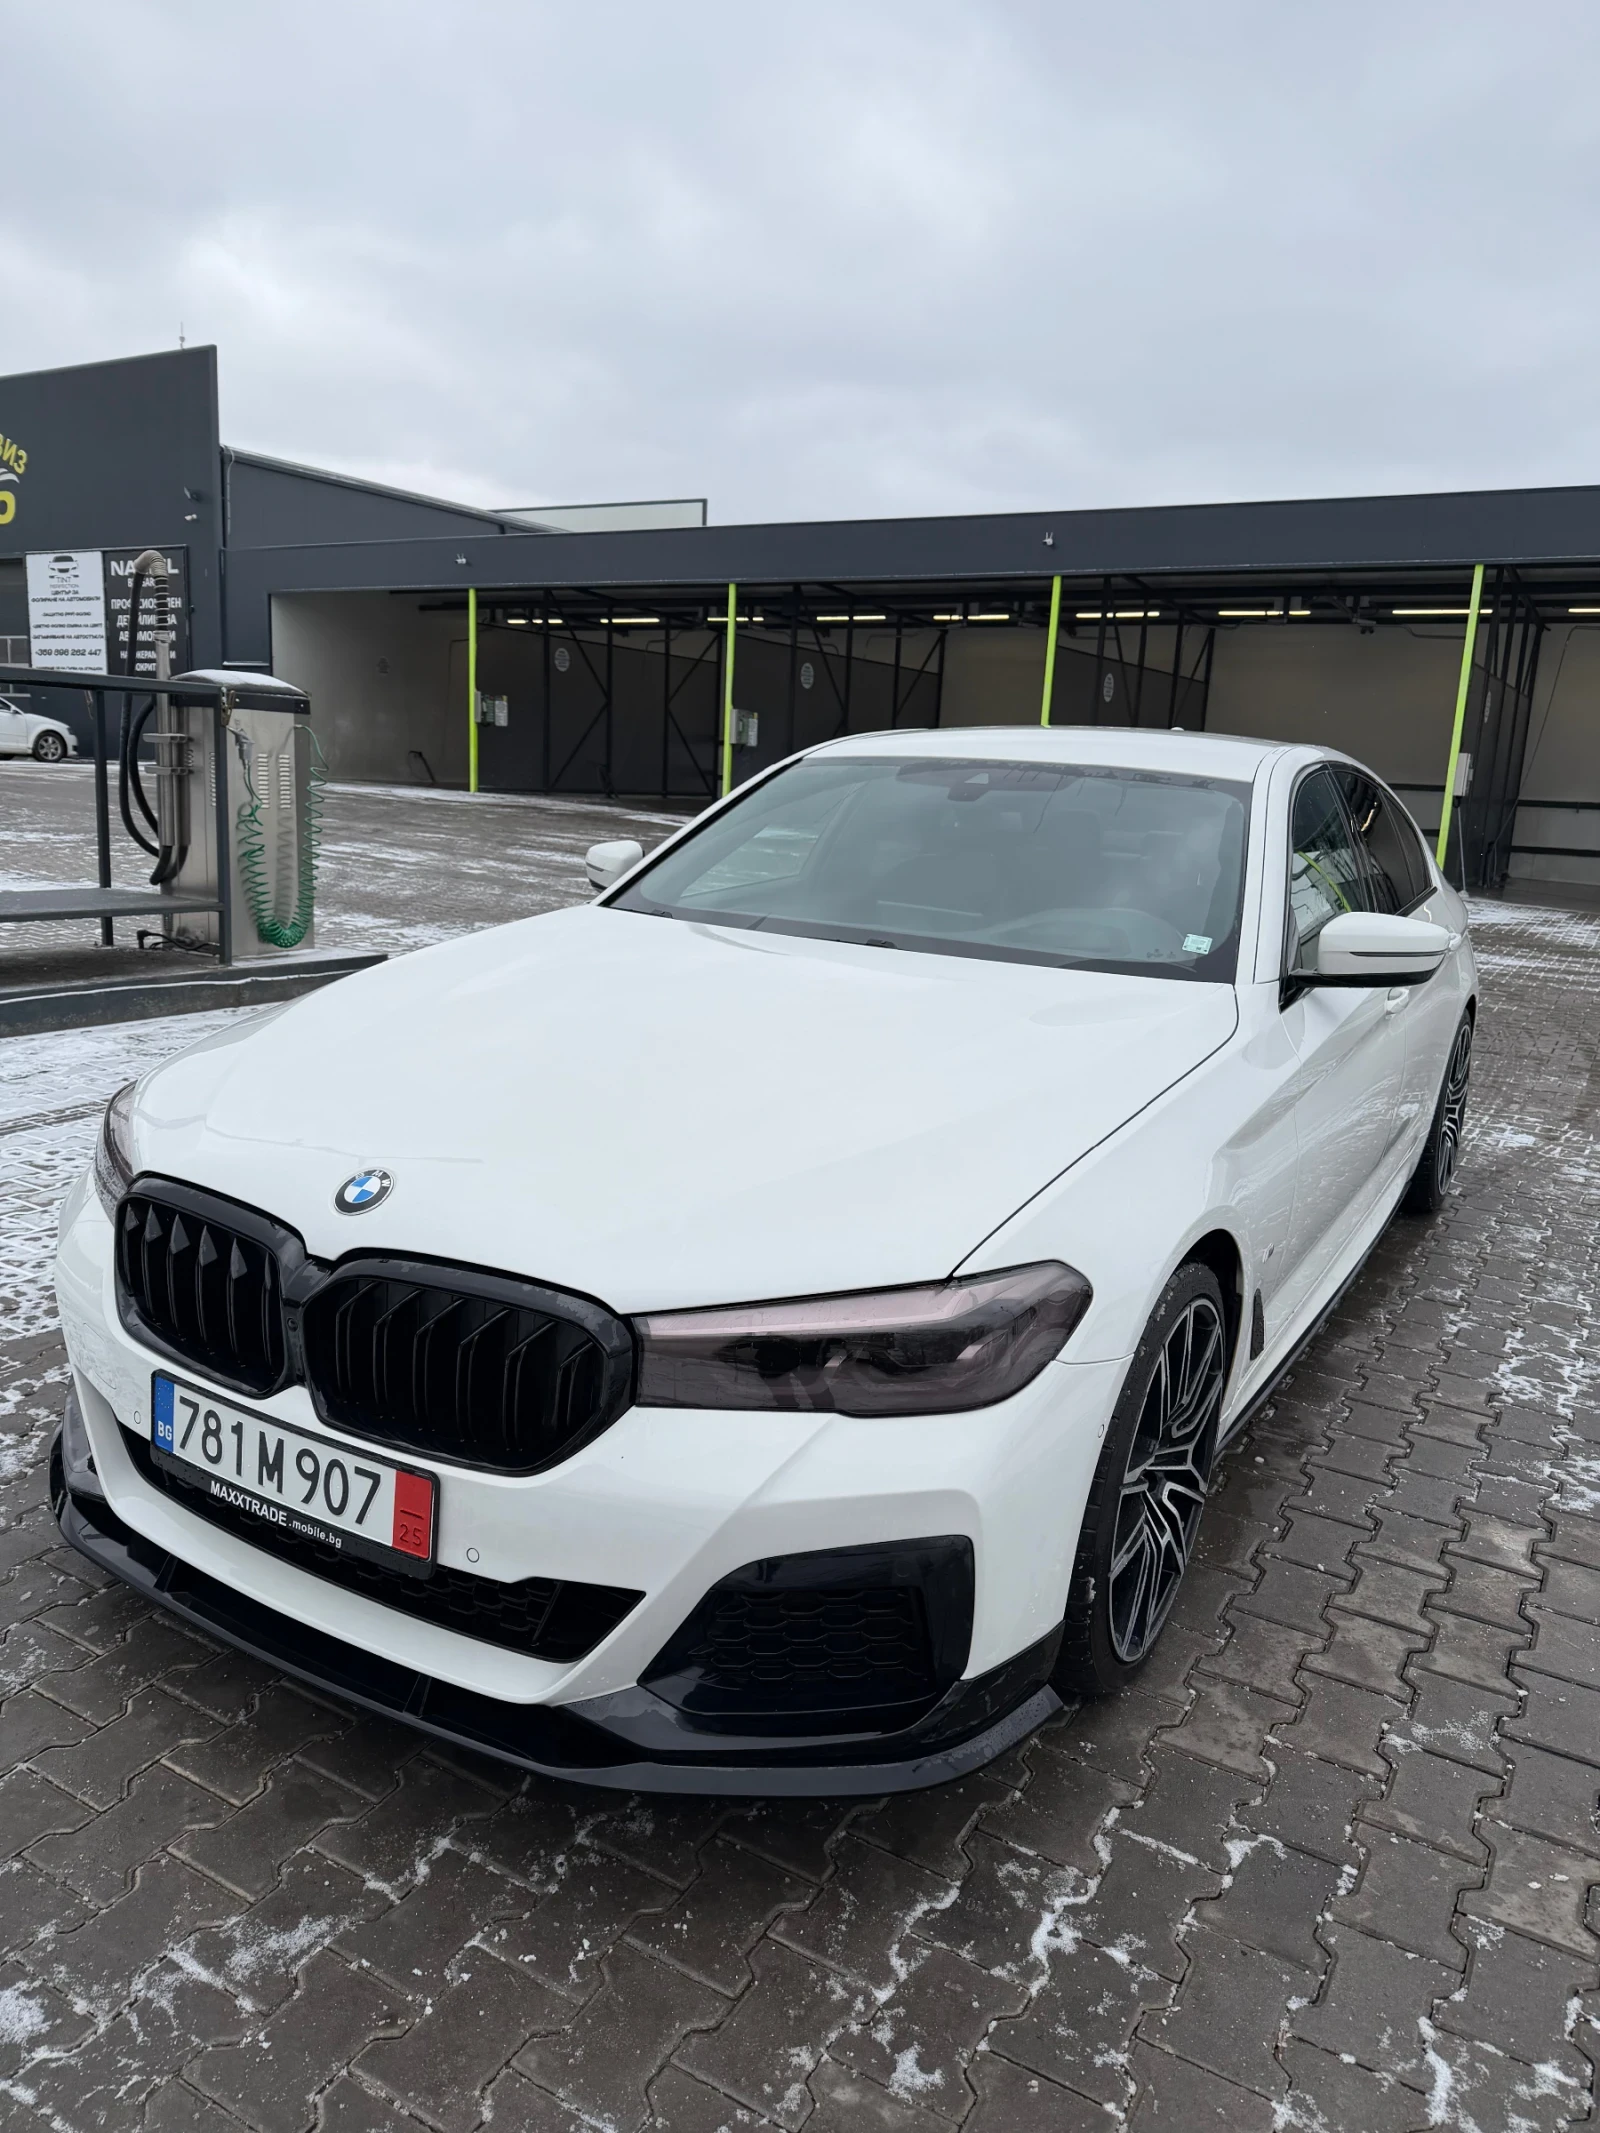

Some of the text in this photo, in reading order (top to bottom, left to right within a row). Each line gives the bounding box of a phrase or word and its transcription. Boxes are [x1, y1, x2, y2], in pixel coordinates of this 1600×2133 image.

[110, 558, 180, 576] NAL
[157, 1420, 173, 1441] BG
[399, 1523, 423, 1547] 25
